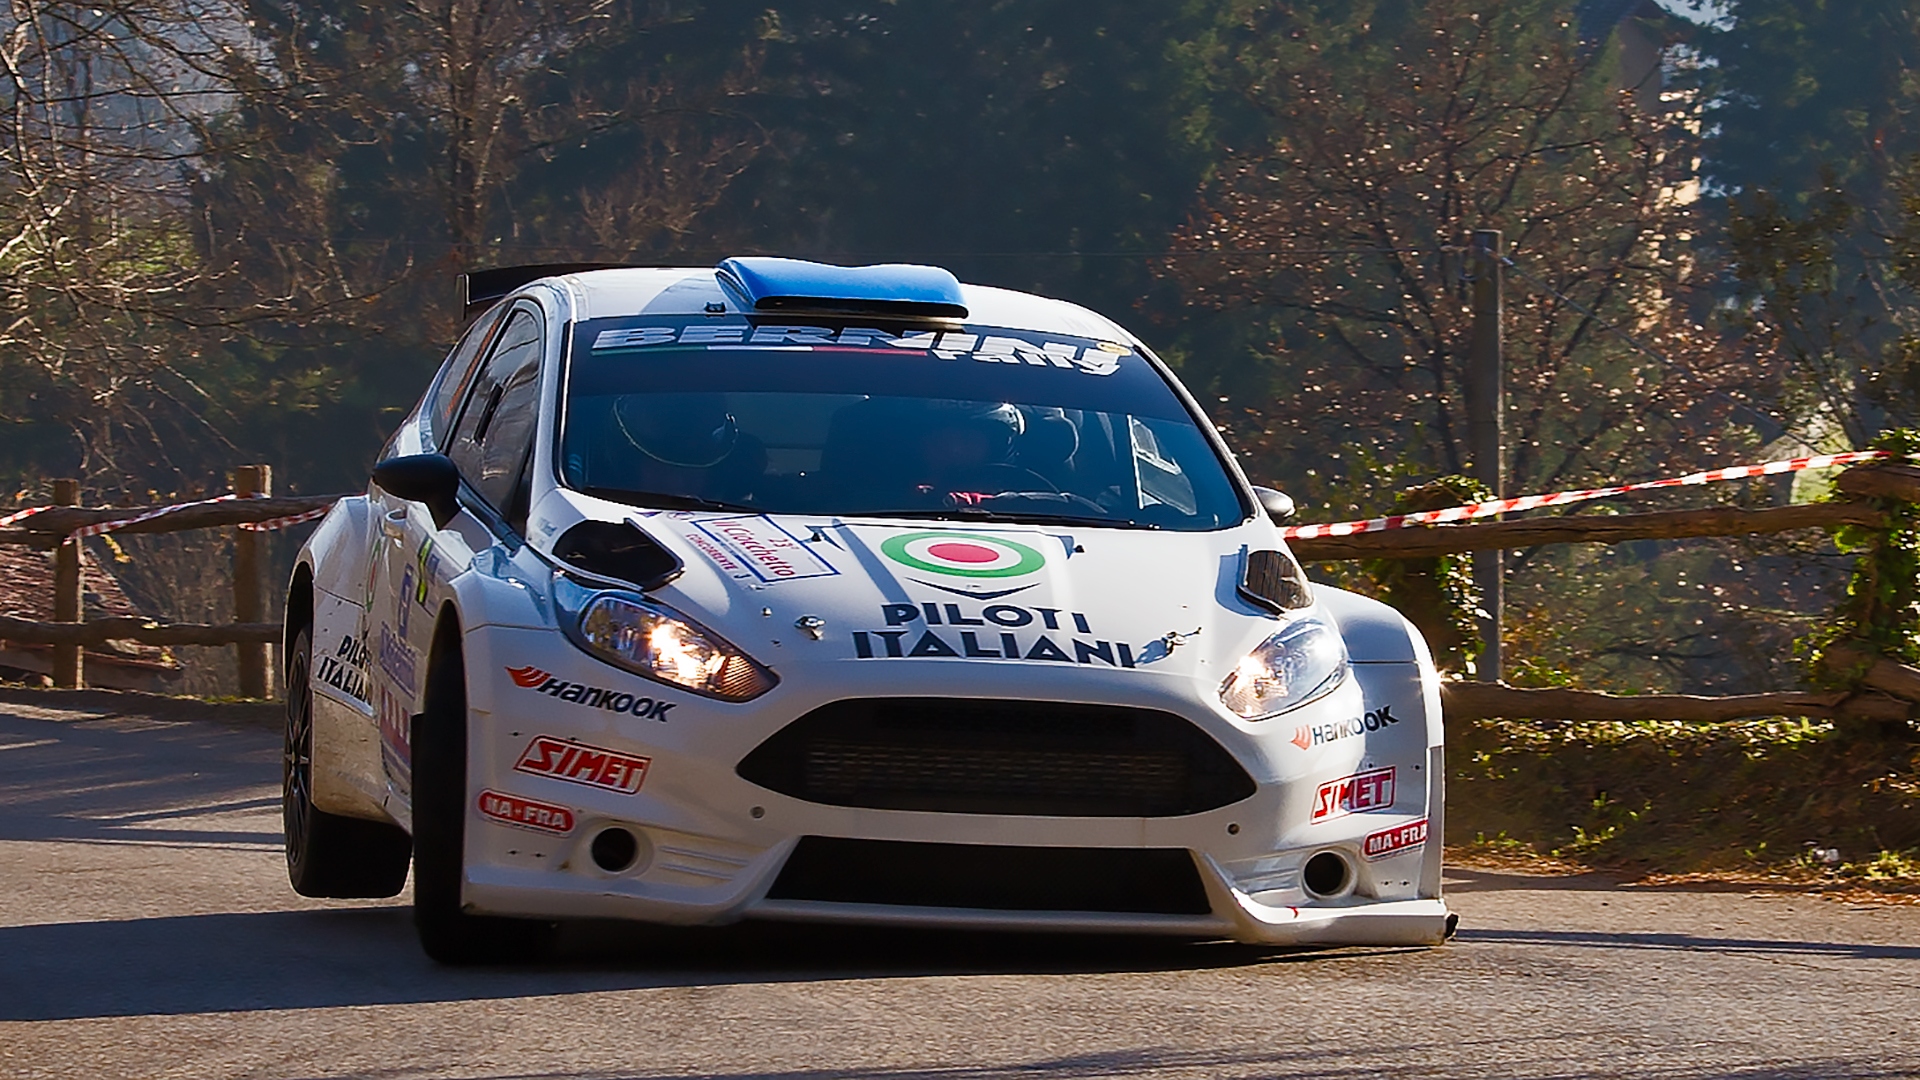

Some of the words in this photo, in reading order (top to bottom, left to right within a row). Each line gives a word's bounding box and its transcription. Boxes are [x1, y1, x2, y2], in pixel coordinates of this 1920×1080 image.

[723, 527, 797, 577] Ciocchetto
[880, 603, 1092, 633] PILOTI
[852, 629, 1137, 668] ITALIANI
[522, 740, 646, 789] SIMET
[1313, 772, 1392, 819] SIMET
